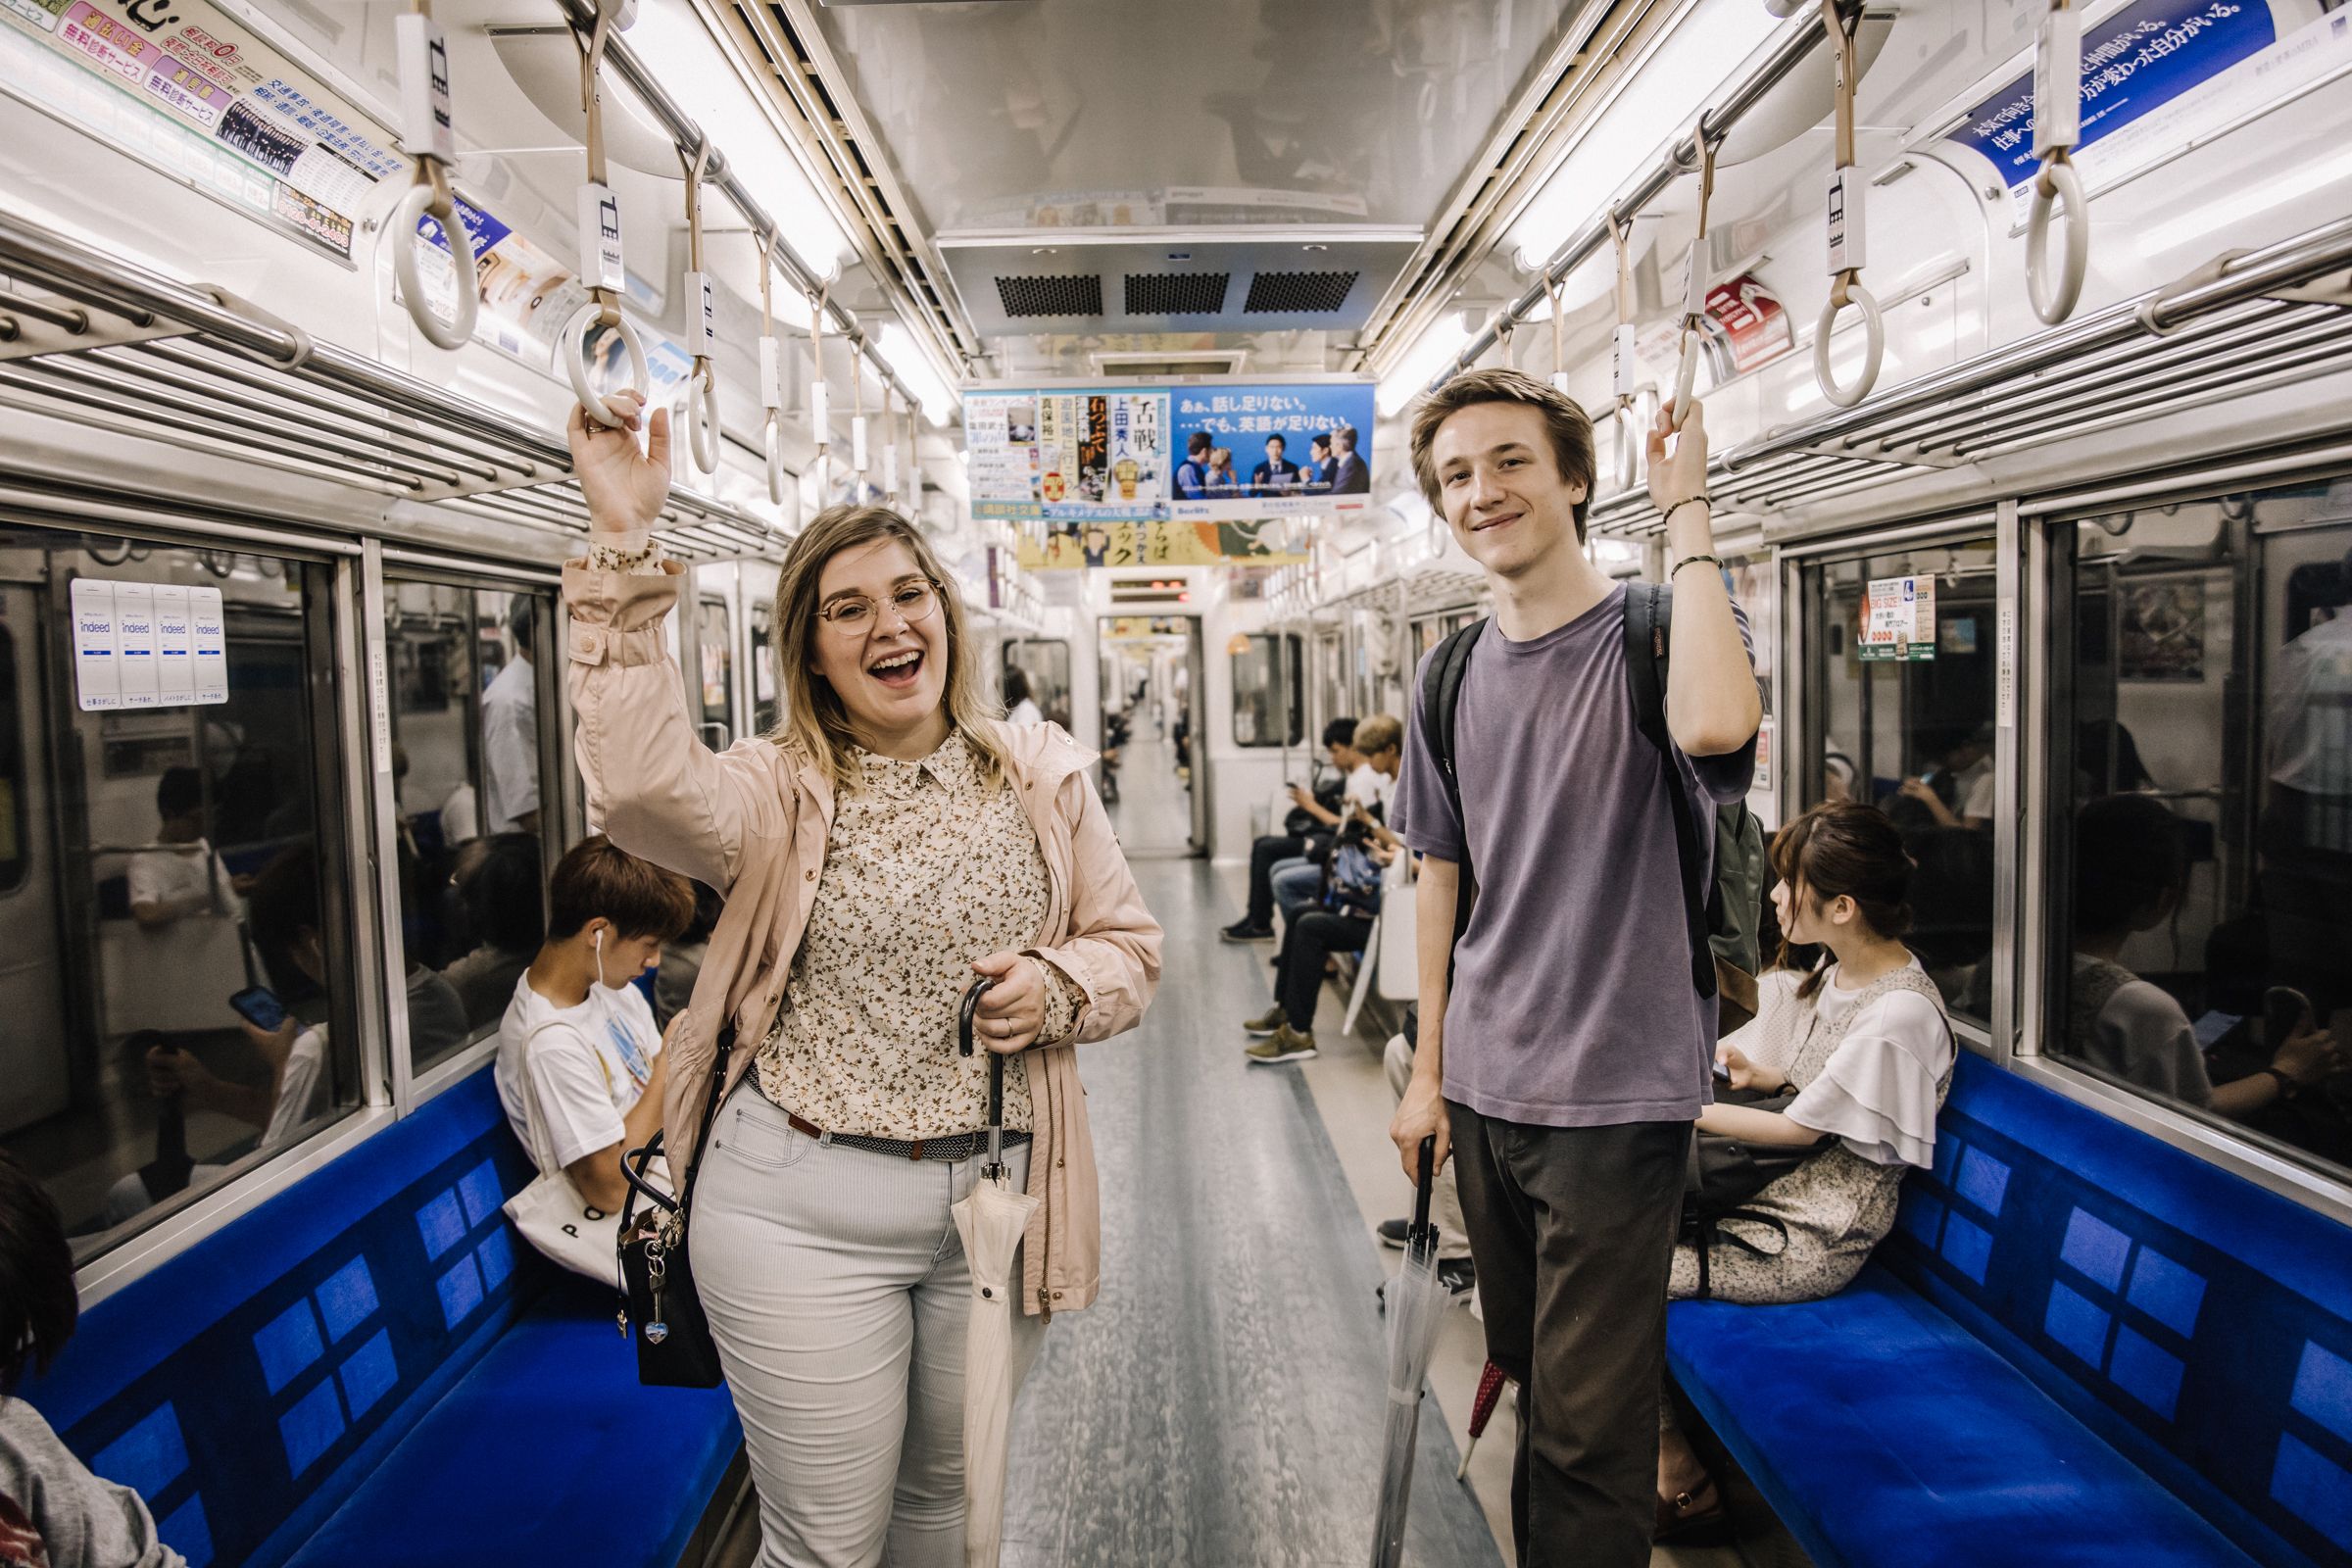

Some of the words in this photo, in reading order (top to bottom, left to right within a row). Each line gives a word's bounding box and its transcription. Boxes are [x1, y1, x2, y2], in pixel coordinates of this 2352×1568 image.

[82, 11, 145, 57] 過払い金
[64, 23, 142, 78] 無料診断サービス
[148, 75, 214, 122] 無料診断サービス
[1114, 398, 1129, 457] 上田秀人
[1871, 598, 1882, 609] BIG
[80, 619, 110, 633] indeed
[122, 620, 149, 634] indeed
[161, 621, 185, 634] indeed
[196, 622, 220, 635] indeed
